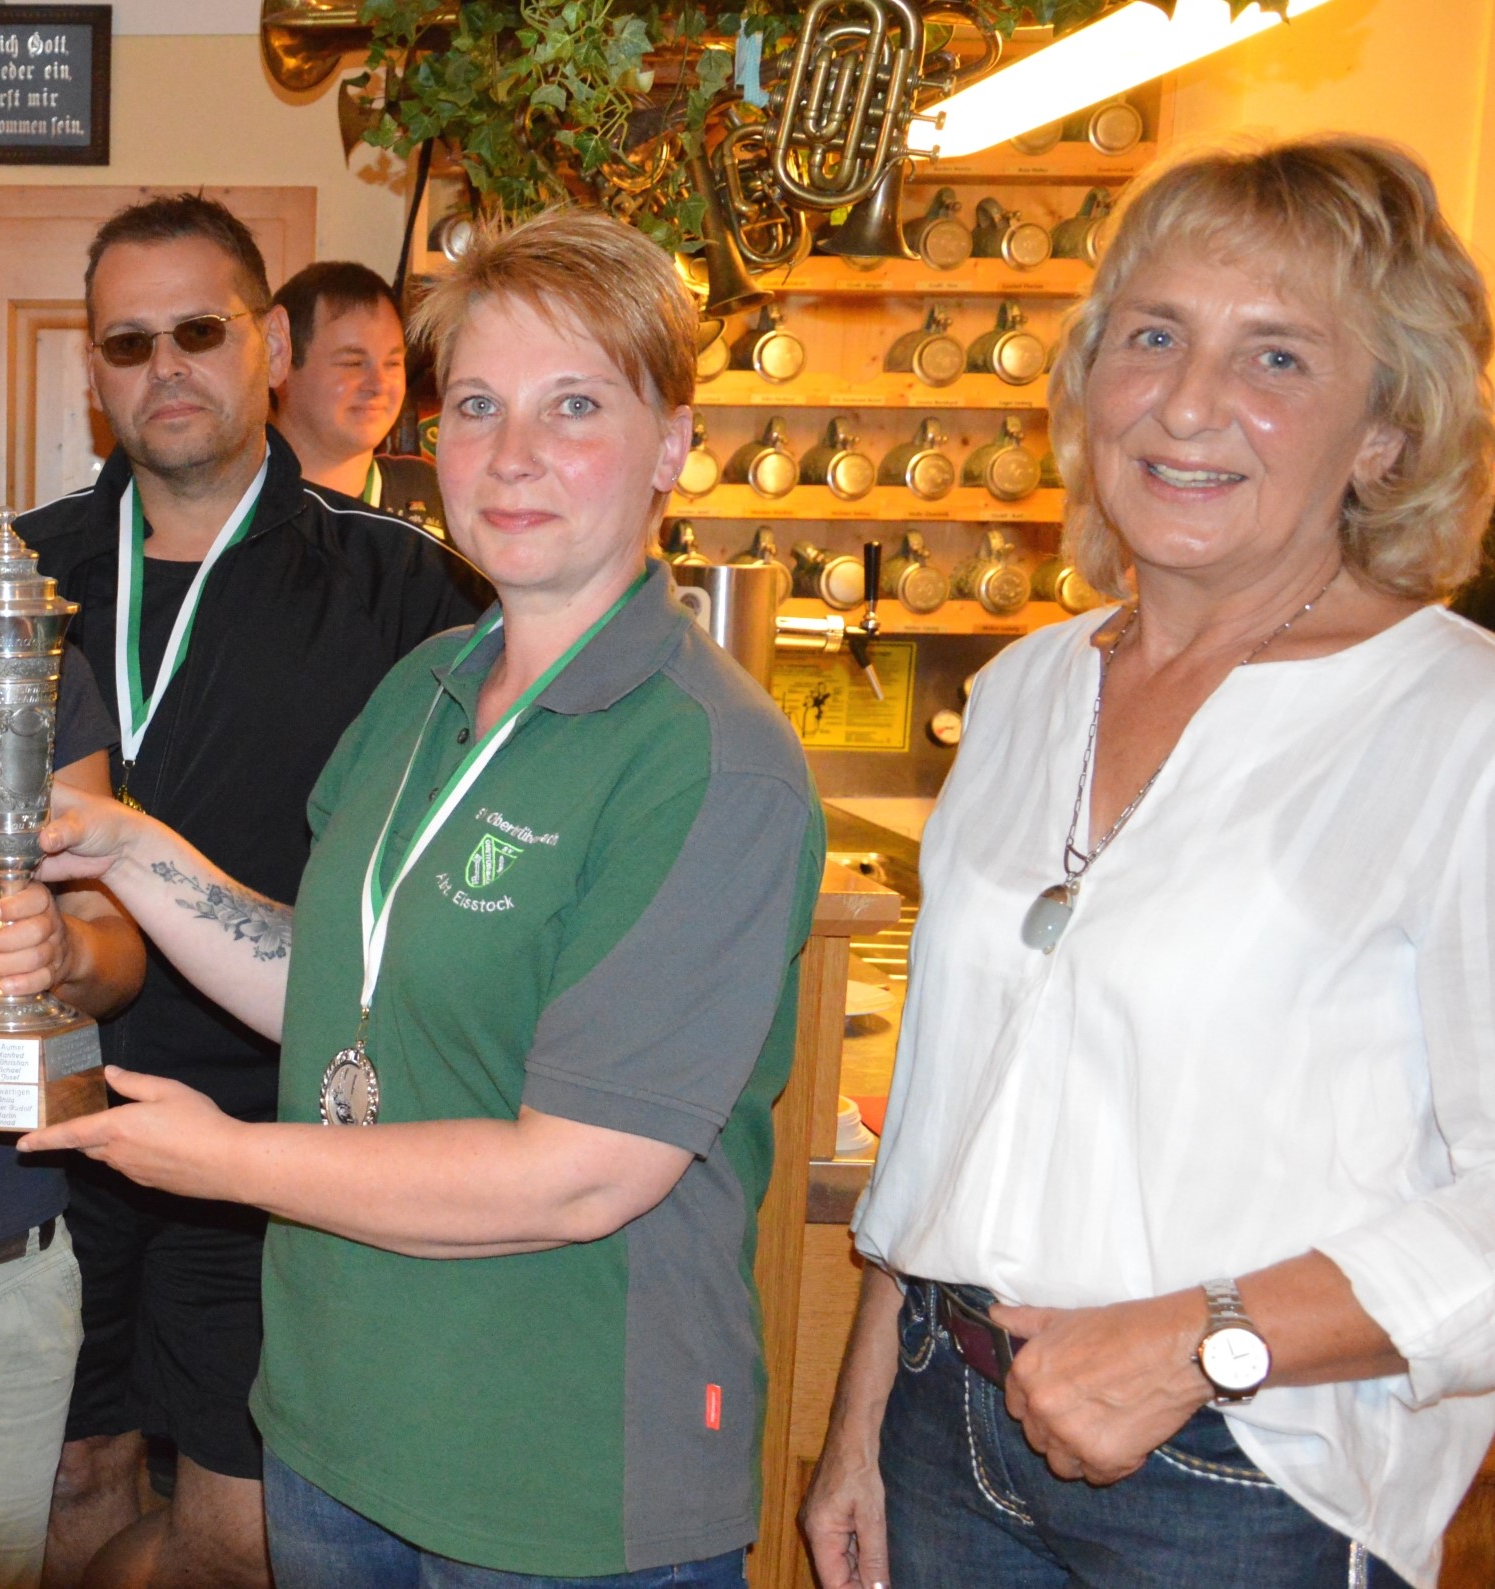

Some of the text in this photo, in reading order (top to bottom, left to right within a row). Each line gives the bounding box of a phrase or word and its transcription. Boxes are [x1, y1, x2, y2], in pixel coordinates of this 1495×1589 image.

[28, 88, 59, 108] mir
[51, 115, 84, 139] sein.
[452, 891, 515, 912] Eisstock
